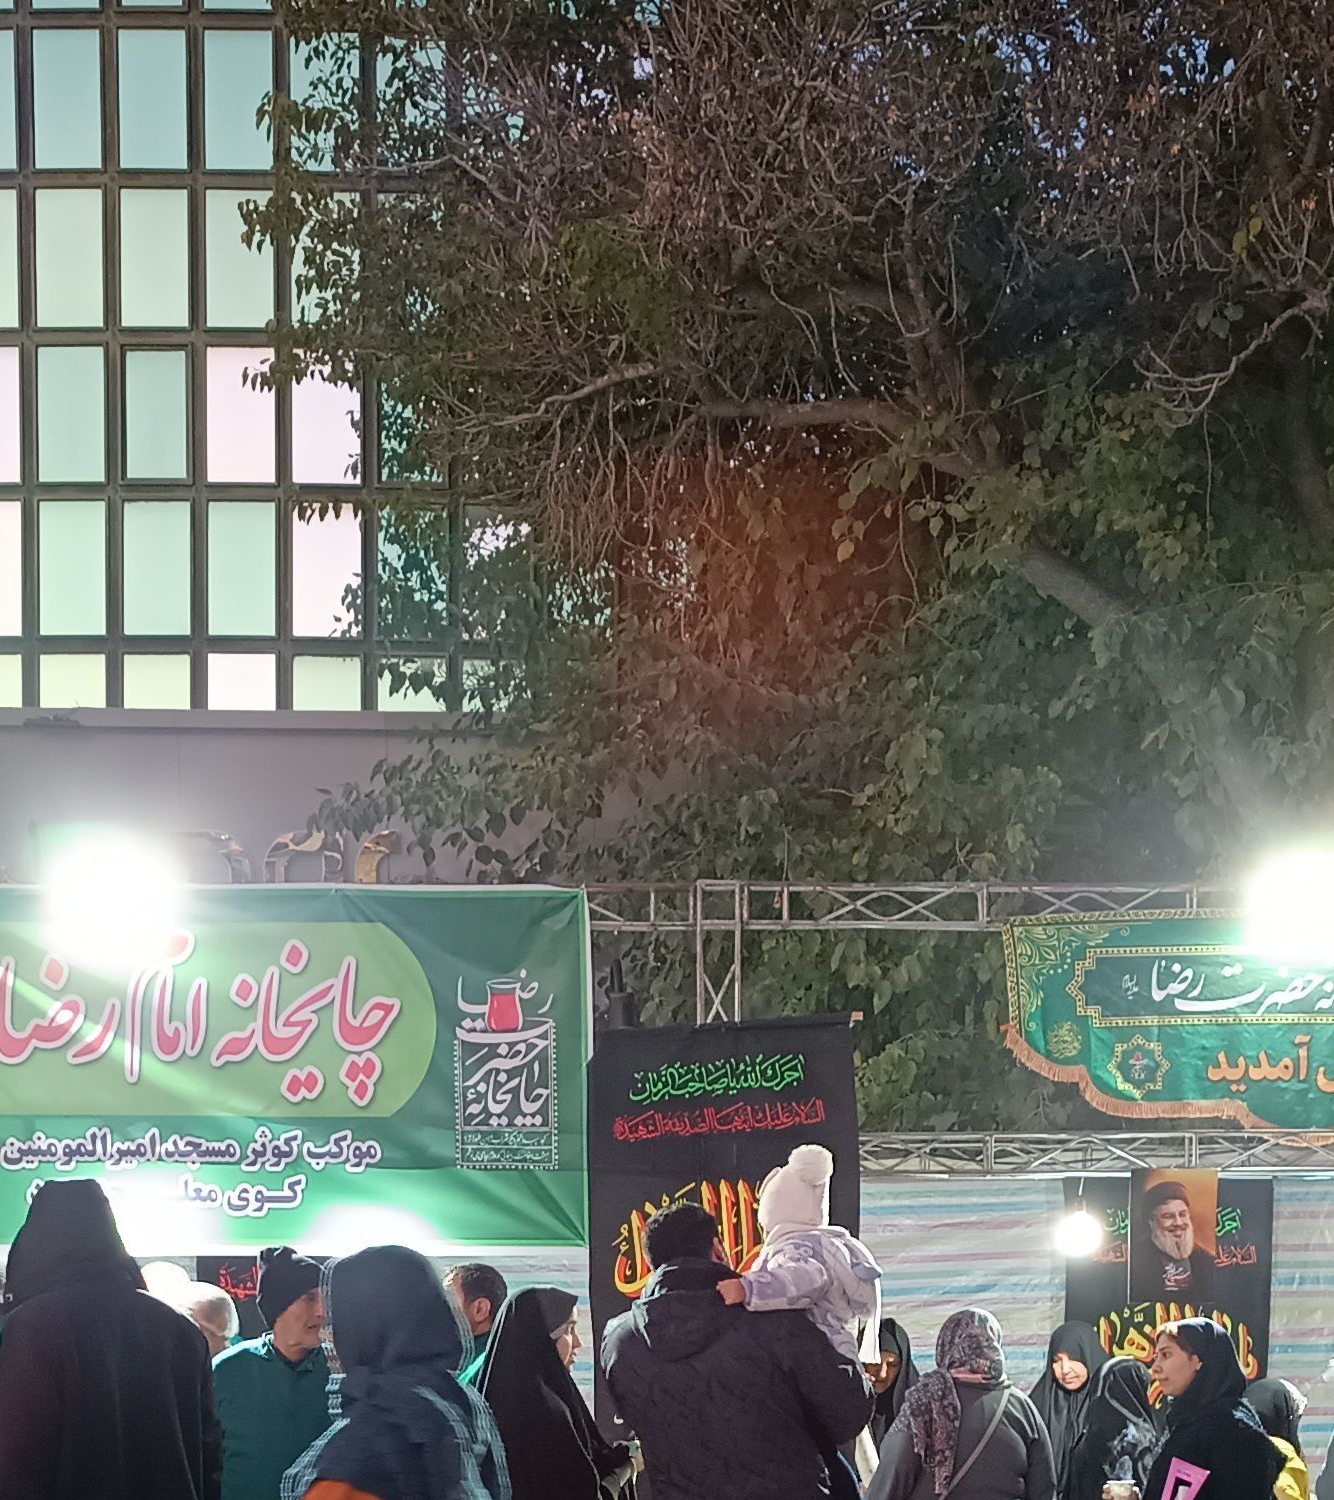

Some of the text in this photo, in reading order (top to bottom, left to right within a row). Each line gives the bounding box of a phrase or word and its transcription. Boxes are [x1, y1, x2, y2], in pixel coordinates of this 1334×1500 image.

[1151, 959, 1206, 1002] رضا
[210, 938, 401, 1107] چایخانه
[1207, 1034, 1313, 1092] آمدید
[161, 1138, 241, 1168] مسجد
[242, 1127, 304, 1172] کوثر
[302, 1130, 382, 1172] موکب
